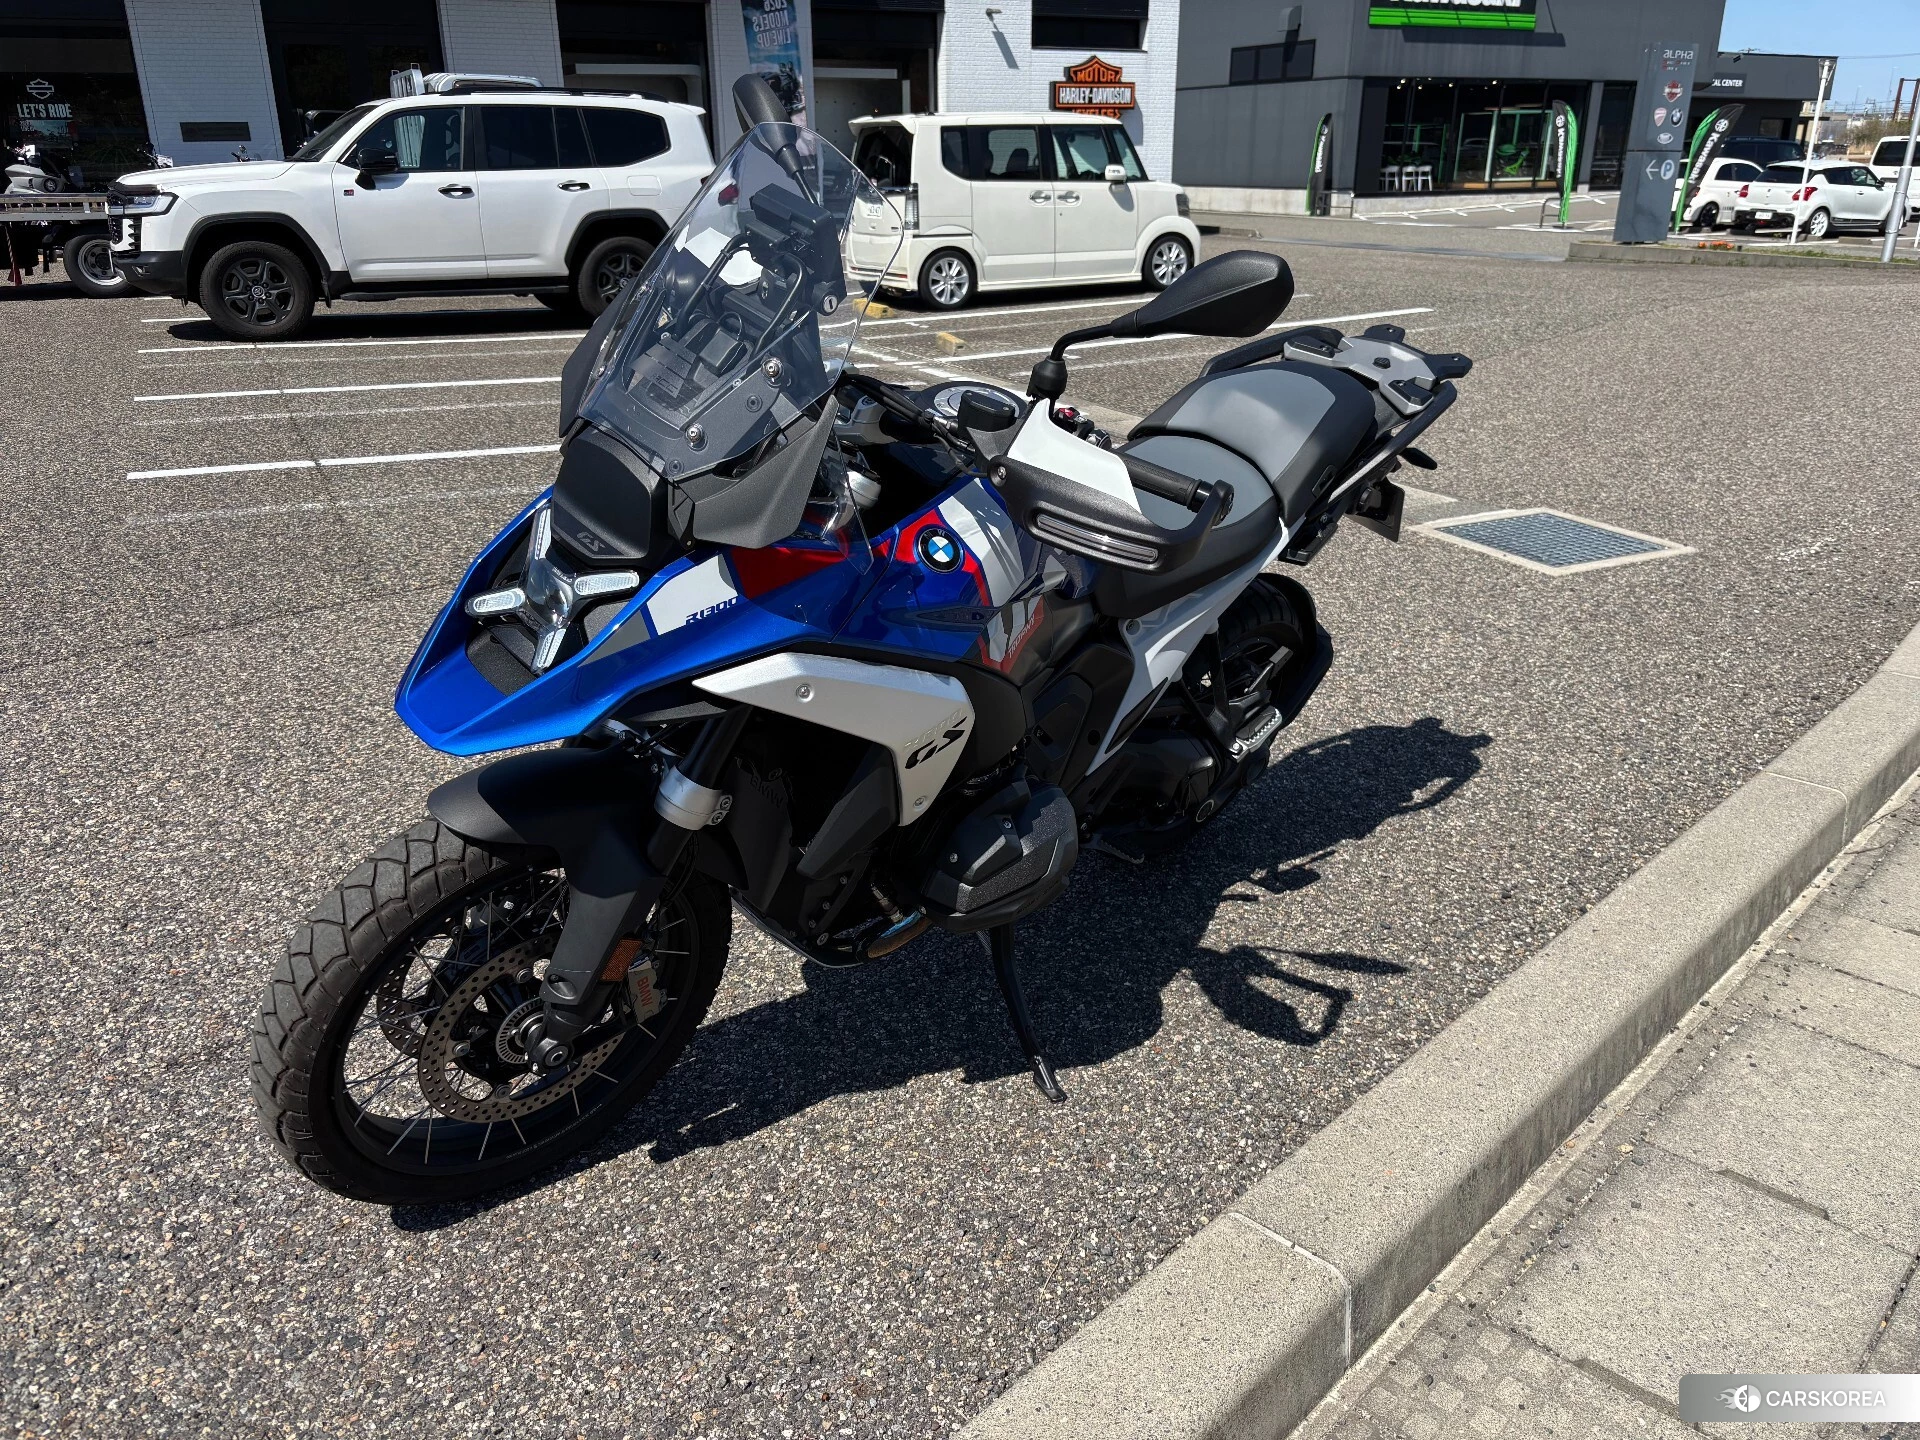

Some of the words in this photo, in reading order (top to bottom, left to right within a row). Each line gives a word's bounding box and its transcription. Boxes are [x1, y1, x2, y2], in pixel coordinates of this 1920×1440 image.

[1077, 63, 1116, 82] MOTOR
[1721, 79, 1743, 87] CENTER
[1060, 87, 1131, 104] HARLEY-DAVIDSON
[17, 104, 46, 118] LET'S
[48, 104, 73, 118] RIDE
[1687, 132, 1720, 184] Kawasaki
[904, 716, 968, 769] GS
[636, 976, 654, 1008] BMW
